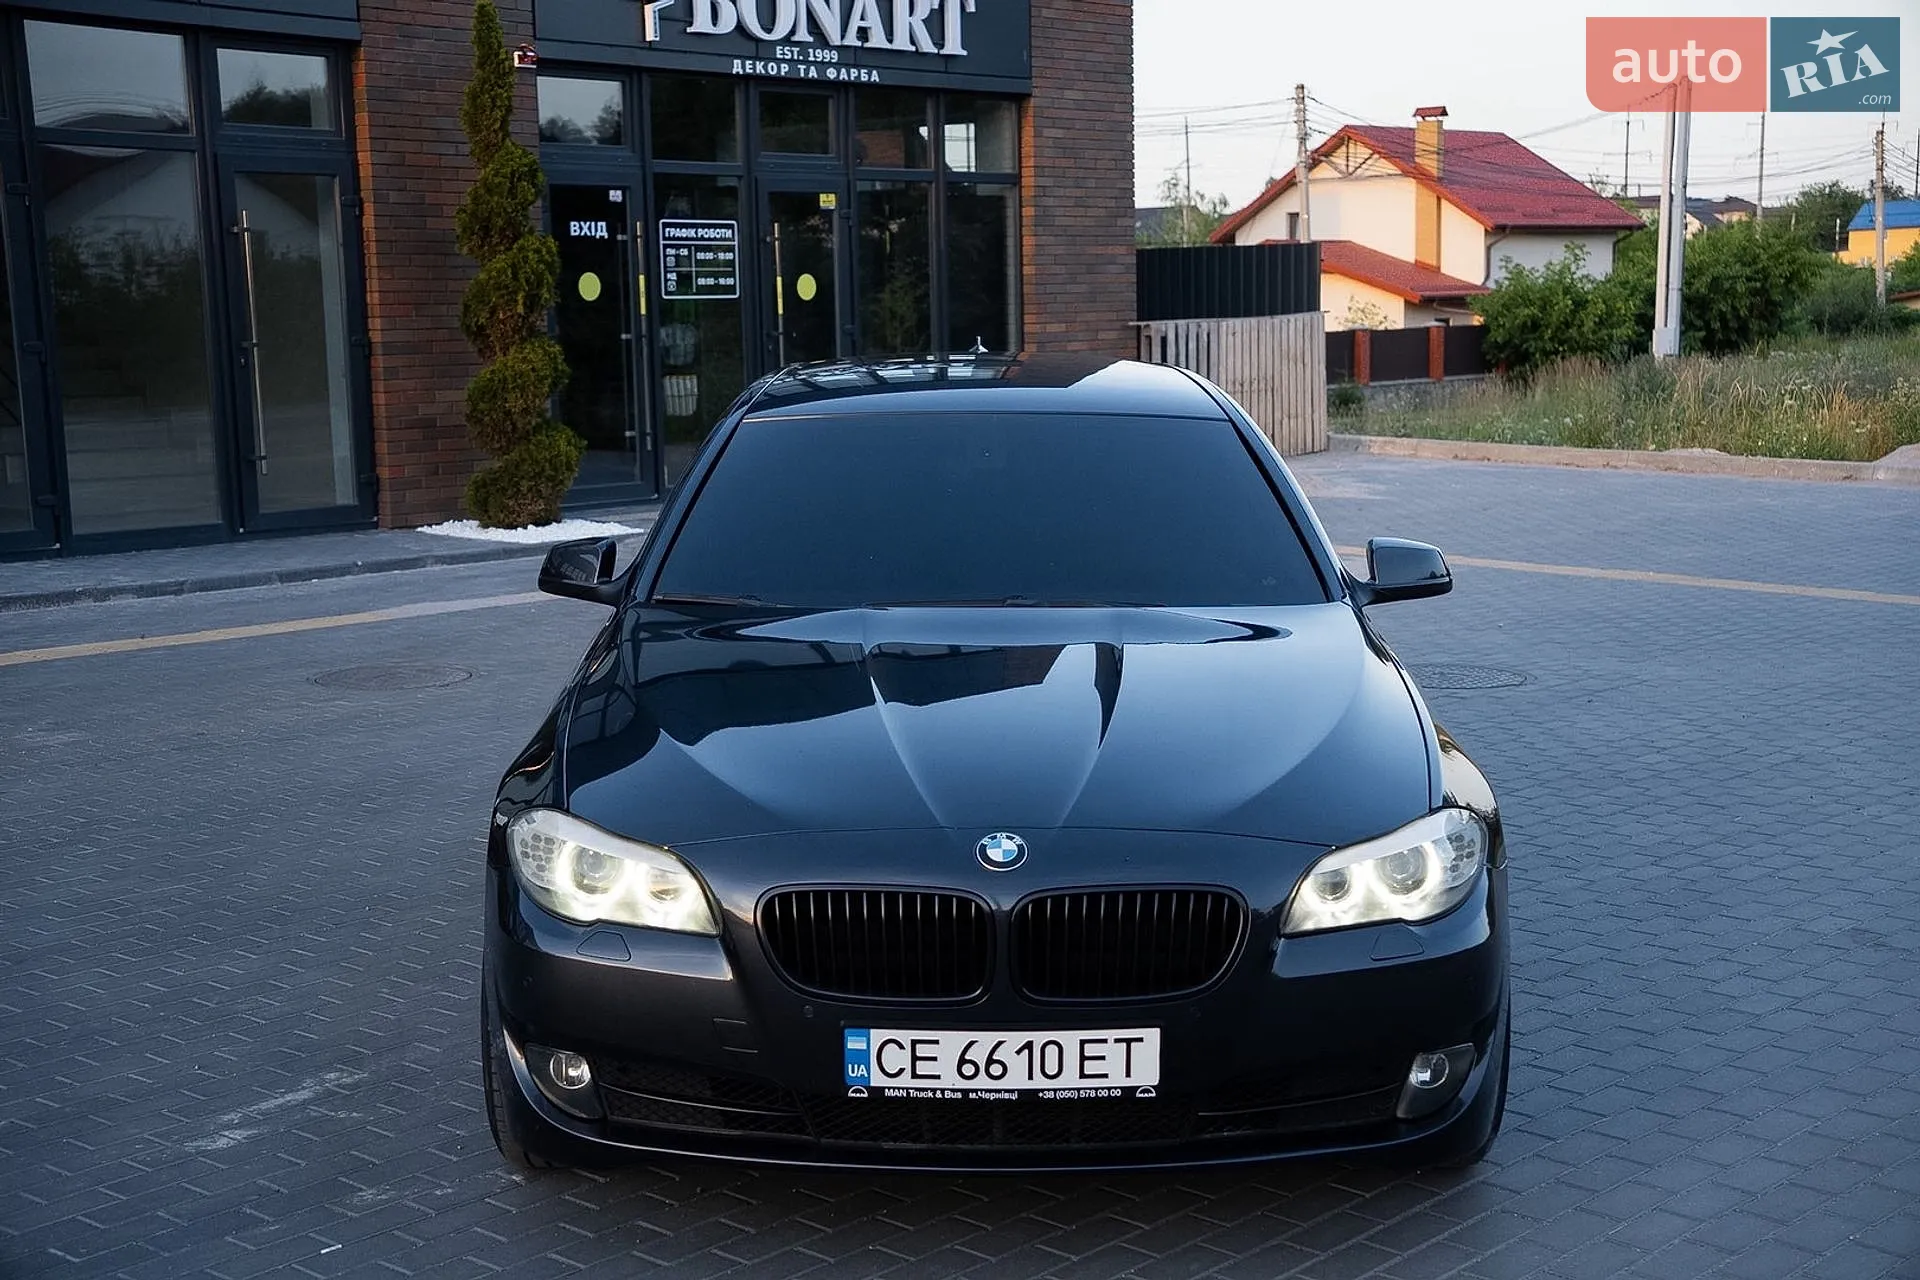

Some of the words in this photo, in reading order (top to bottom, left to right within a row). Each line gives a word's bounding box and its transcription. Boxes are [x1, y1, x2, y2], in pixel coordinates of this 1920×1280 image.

[775, 46, 804, 60] EST.
[807, 48, 839, 63] 1999
[732, 59, 790, 76] ДЕКОР
[797, 64, 818, 78] ТА
[826, 67, 880, 82] ФАРБА
[569, 221, 609, 239] ВХІД
[664, 227, 697, 238] ГРАФІК
[697, 228, 733, 239] РОБОТИ
[875, 1038, 942, 1080] CE
[956, 1039, 1064, 1081] 6610
[1078, 1037, 1145, 1079] ET
[848, 1064, 869, 1078] UA
[884, 1088, 907, 1097] MAN
[908, 1089, 934, 1098] Truck
[935, 1090, 943, 1099] &
[944, 1090, 963, 1099] Bus
[1038, 1090, 1055, 1099] +38
[1056, 1089, 1078, 1100] (050)
[1079, 1089, 1096, 1098] 578
[1097, 1088, 1109, 1097] 00
[1110, 1088, 1122, 1097] 00
